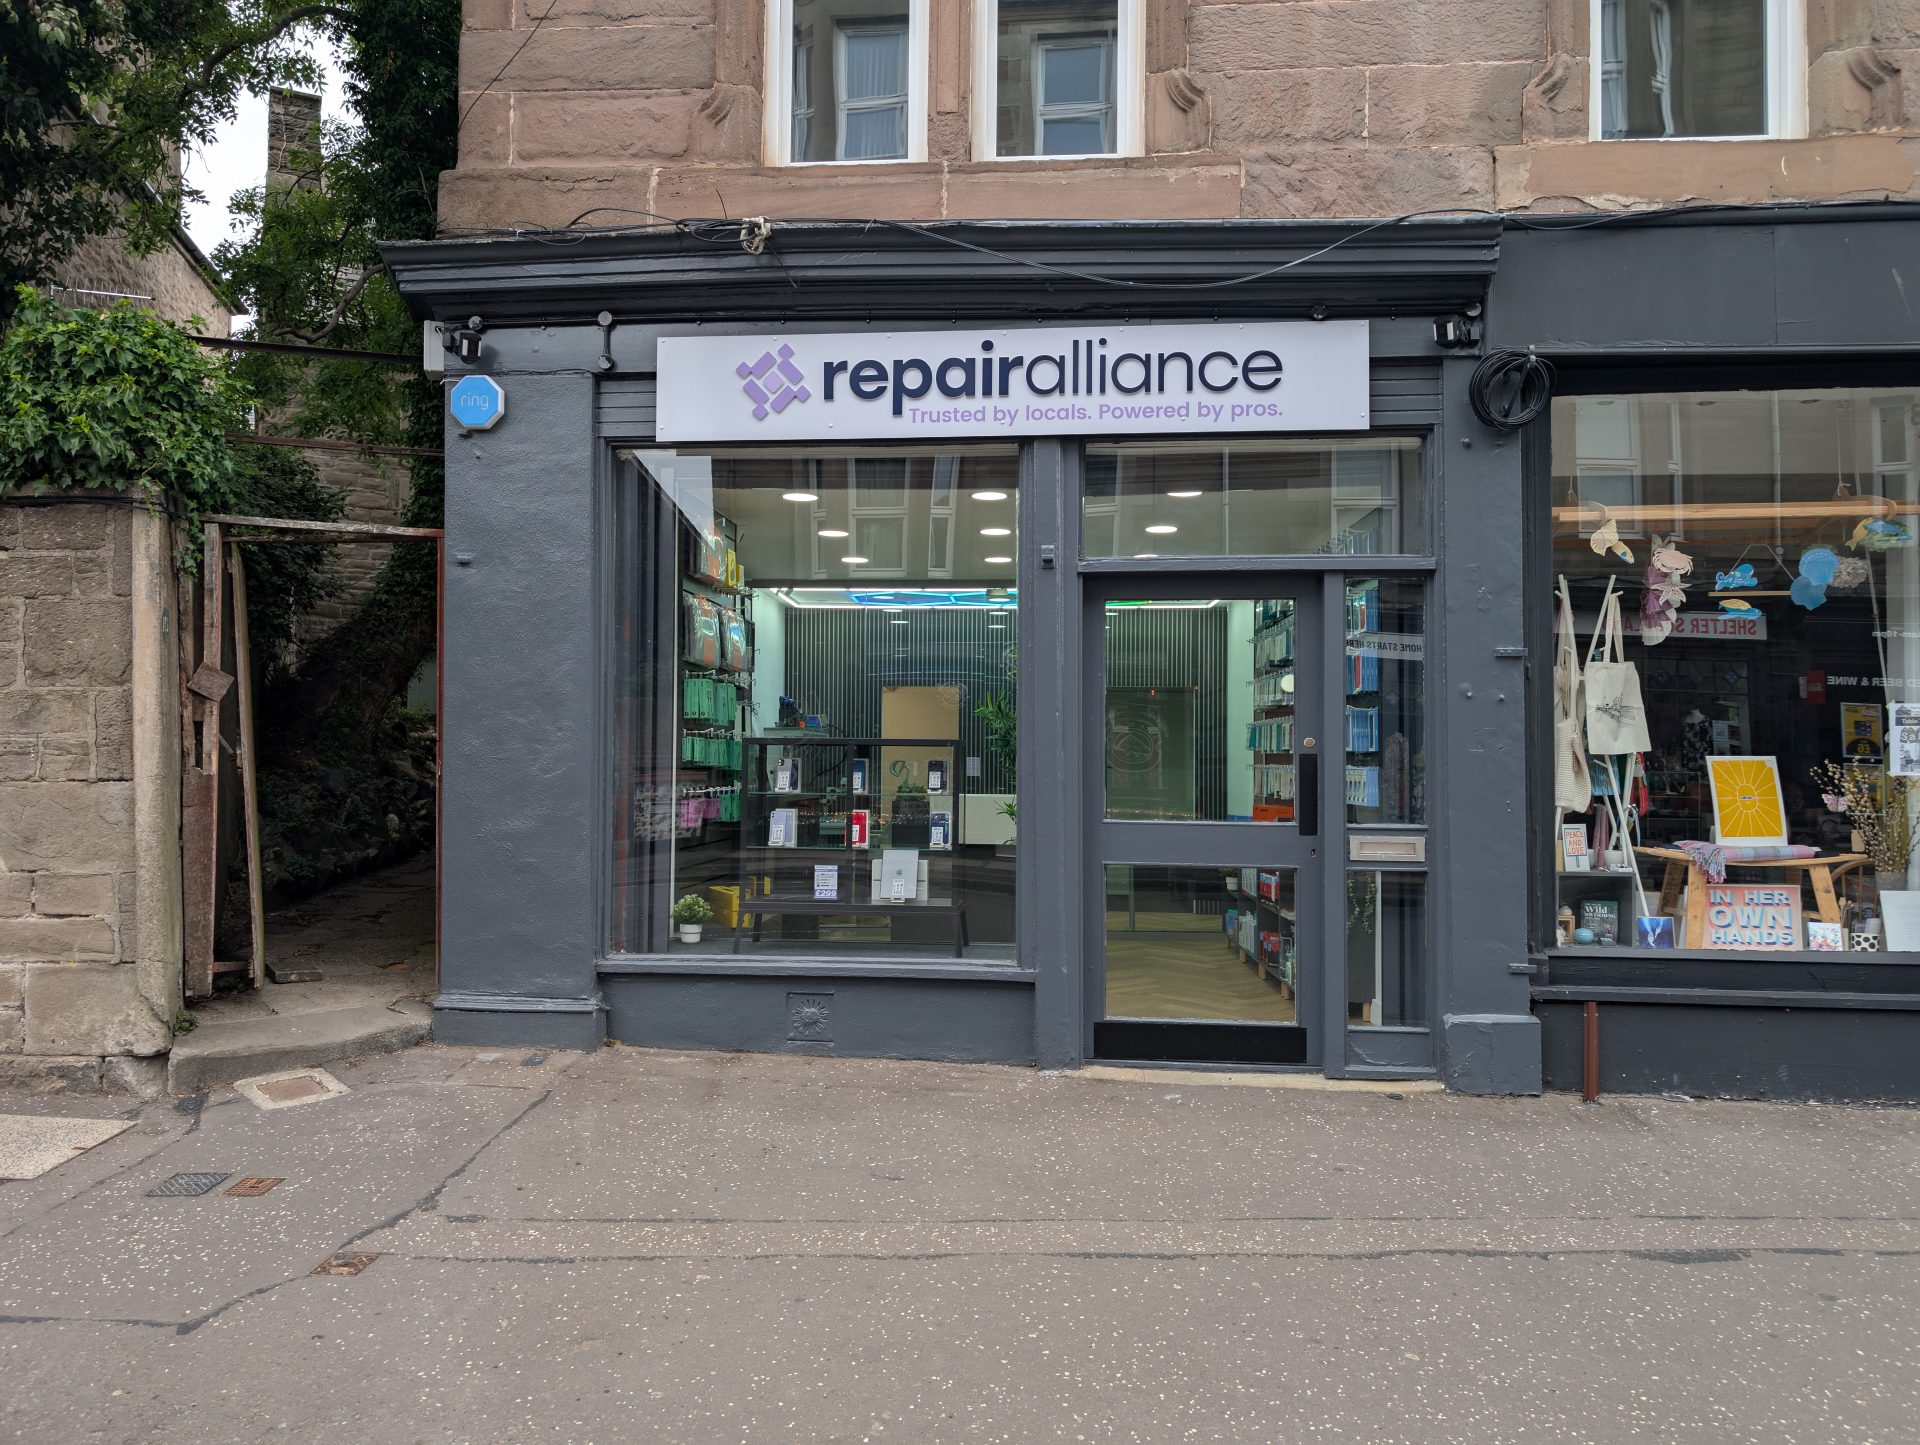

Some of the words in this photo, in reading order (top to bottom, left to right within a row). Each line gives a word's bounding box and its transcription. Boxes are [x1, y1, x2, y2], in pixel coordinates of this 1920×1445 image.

[823, 338, 1283, 416] repairalliance
[461, 392, 488, 410] ring
[909, 406, 986, 423] Trusted
[993, 405, 1018, 425] by
[1025, 403, 1091, 421] locals.
[1099, 401, 1190, 420] Powered
[1197, 400, 1223, 422] by
[1231, 403, 1282, 423] pros.
[815, 889, 837, 897] £299
[1709, 889, 1734, 906] IN
[1744, 889, 1791, 906] HER
[1709, 906, 1792, 929] OWN
[1711, 929, 1795, 946] HANDS
